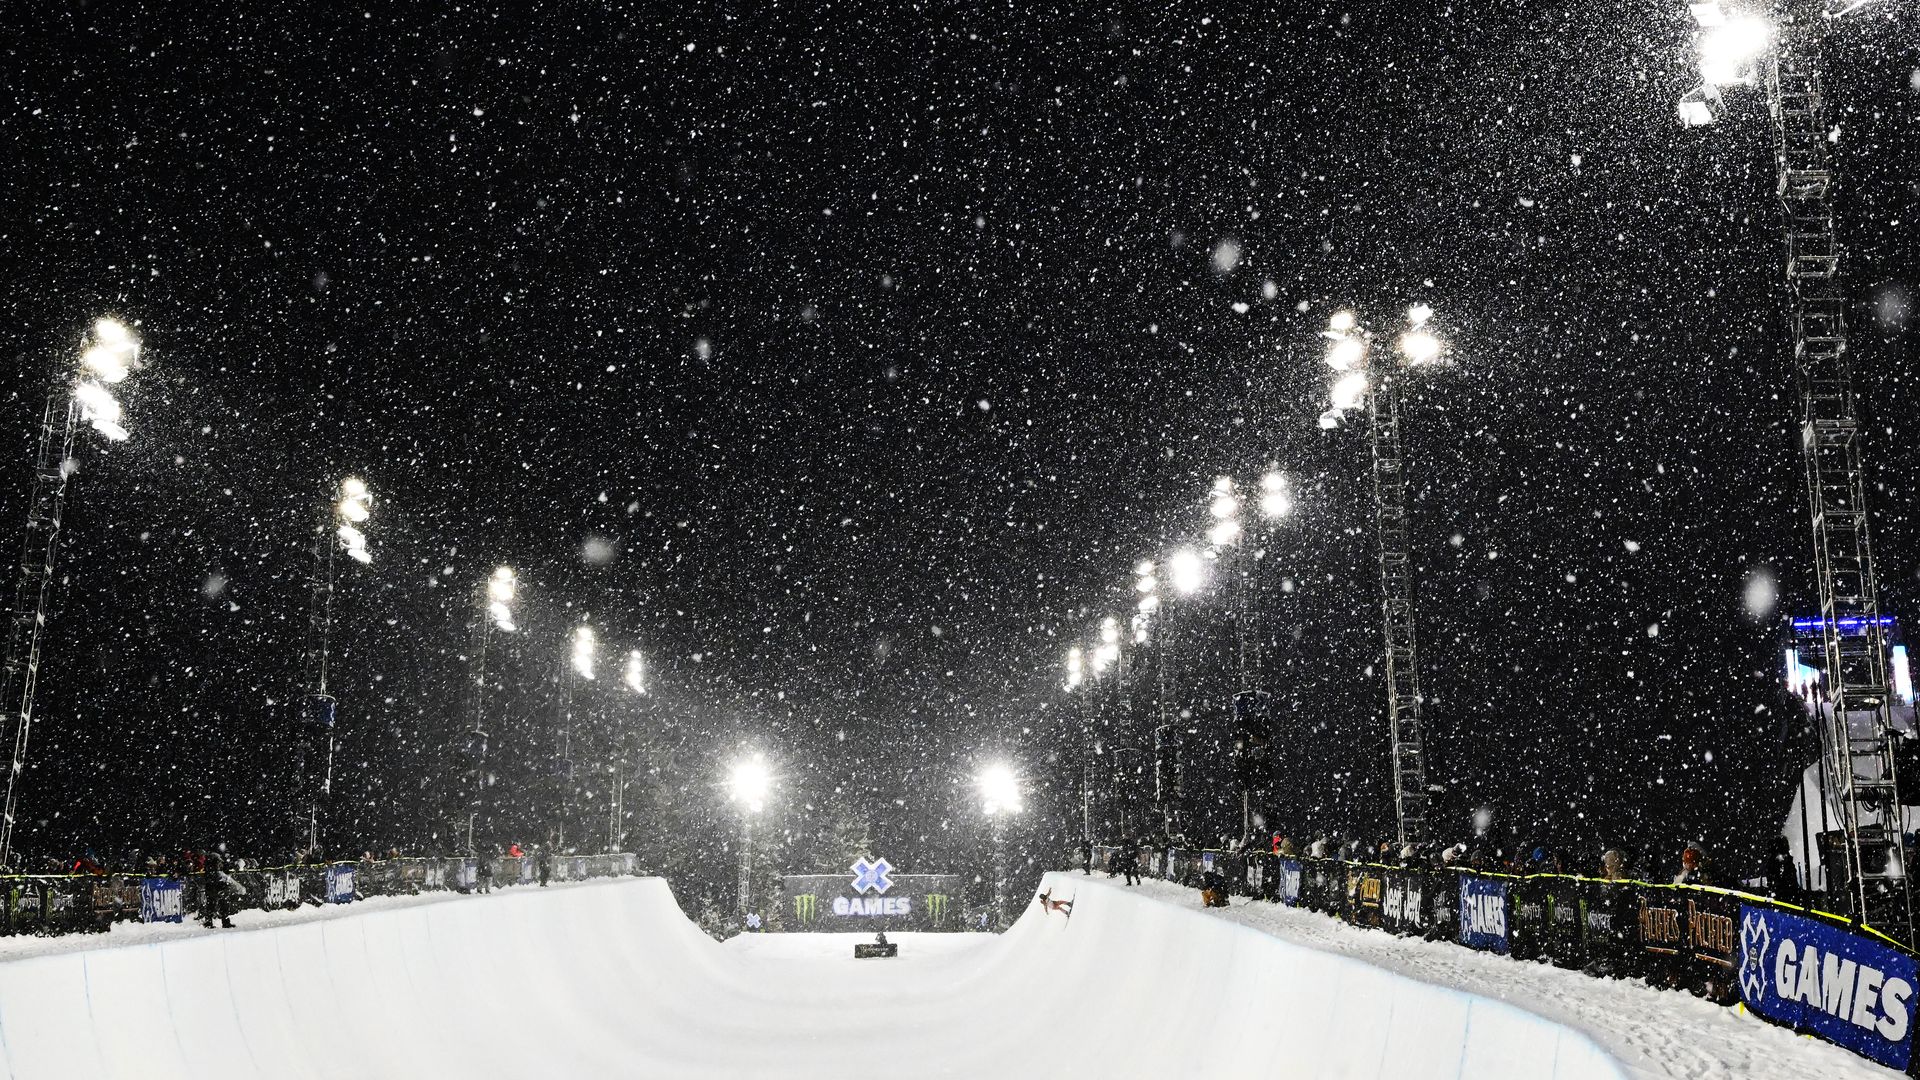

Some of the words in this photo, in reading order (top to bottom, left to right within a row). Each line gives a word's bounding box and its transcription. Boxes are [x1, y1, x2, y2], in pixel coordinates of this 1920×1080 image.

[833, 896, 911, 915] GAMES
[1467, 893, 1504, 937] GAMES
[1775, 939, 1912, 1042] GAMES
